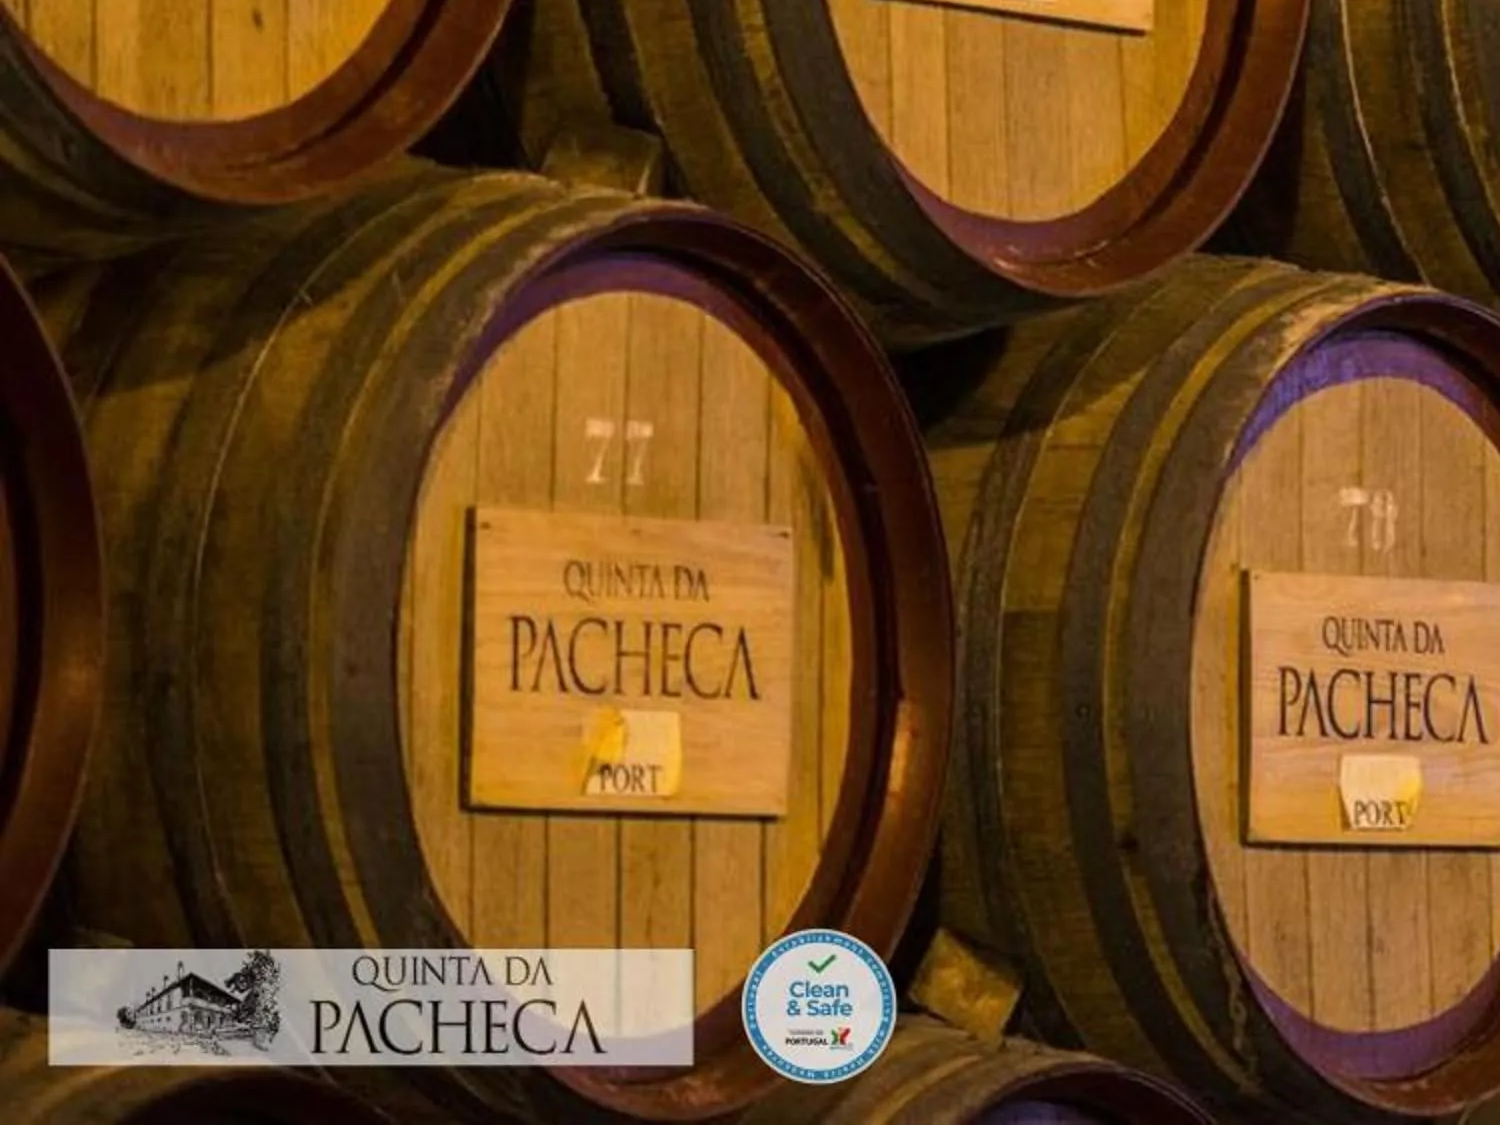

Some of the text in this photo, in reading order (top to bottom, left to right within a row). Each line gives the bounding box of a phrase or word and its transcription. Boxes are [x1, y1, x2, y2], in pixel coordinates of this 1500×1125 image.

[585, 417, 655, 485] 77
[562, 559, 711, 606] QUINTA DA
[508, 615, 761, 701] PACHECA
[1321, 616, 1446, 657] QUINTA DA
[1277, 666, 1490, 745] PACHECA
[599, 763, 664, 794] PORT
[1353, 799, 1411, 826] PORT
